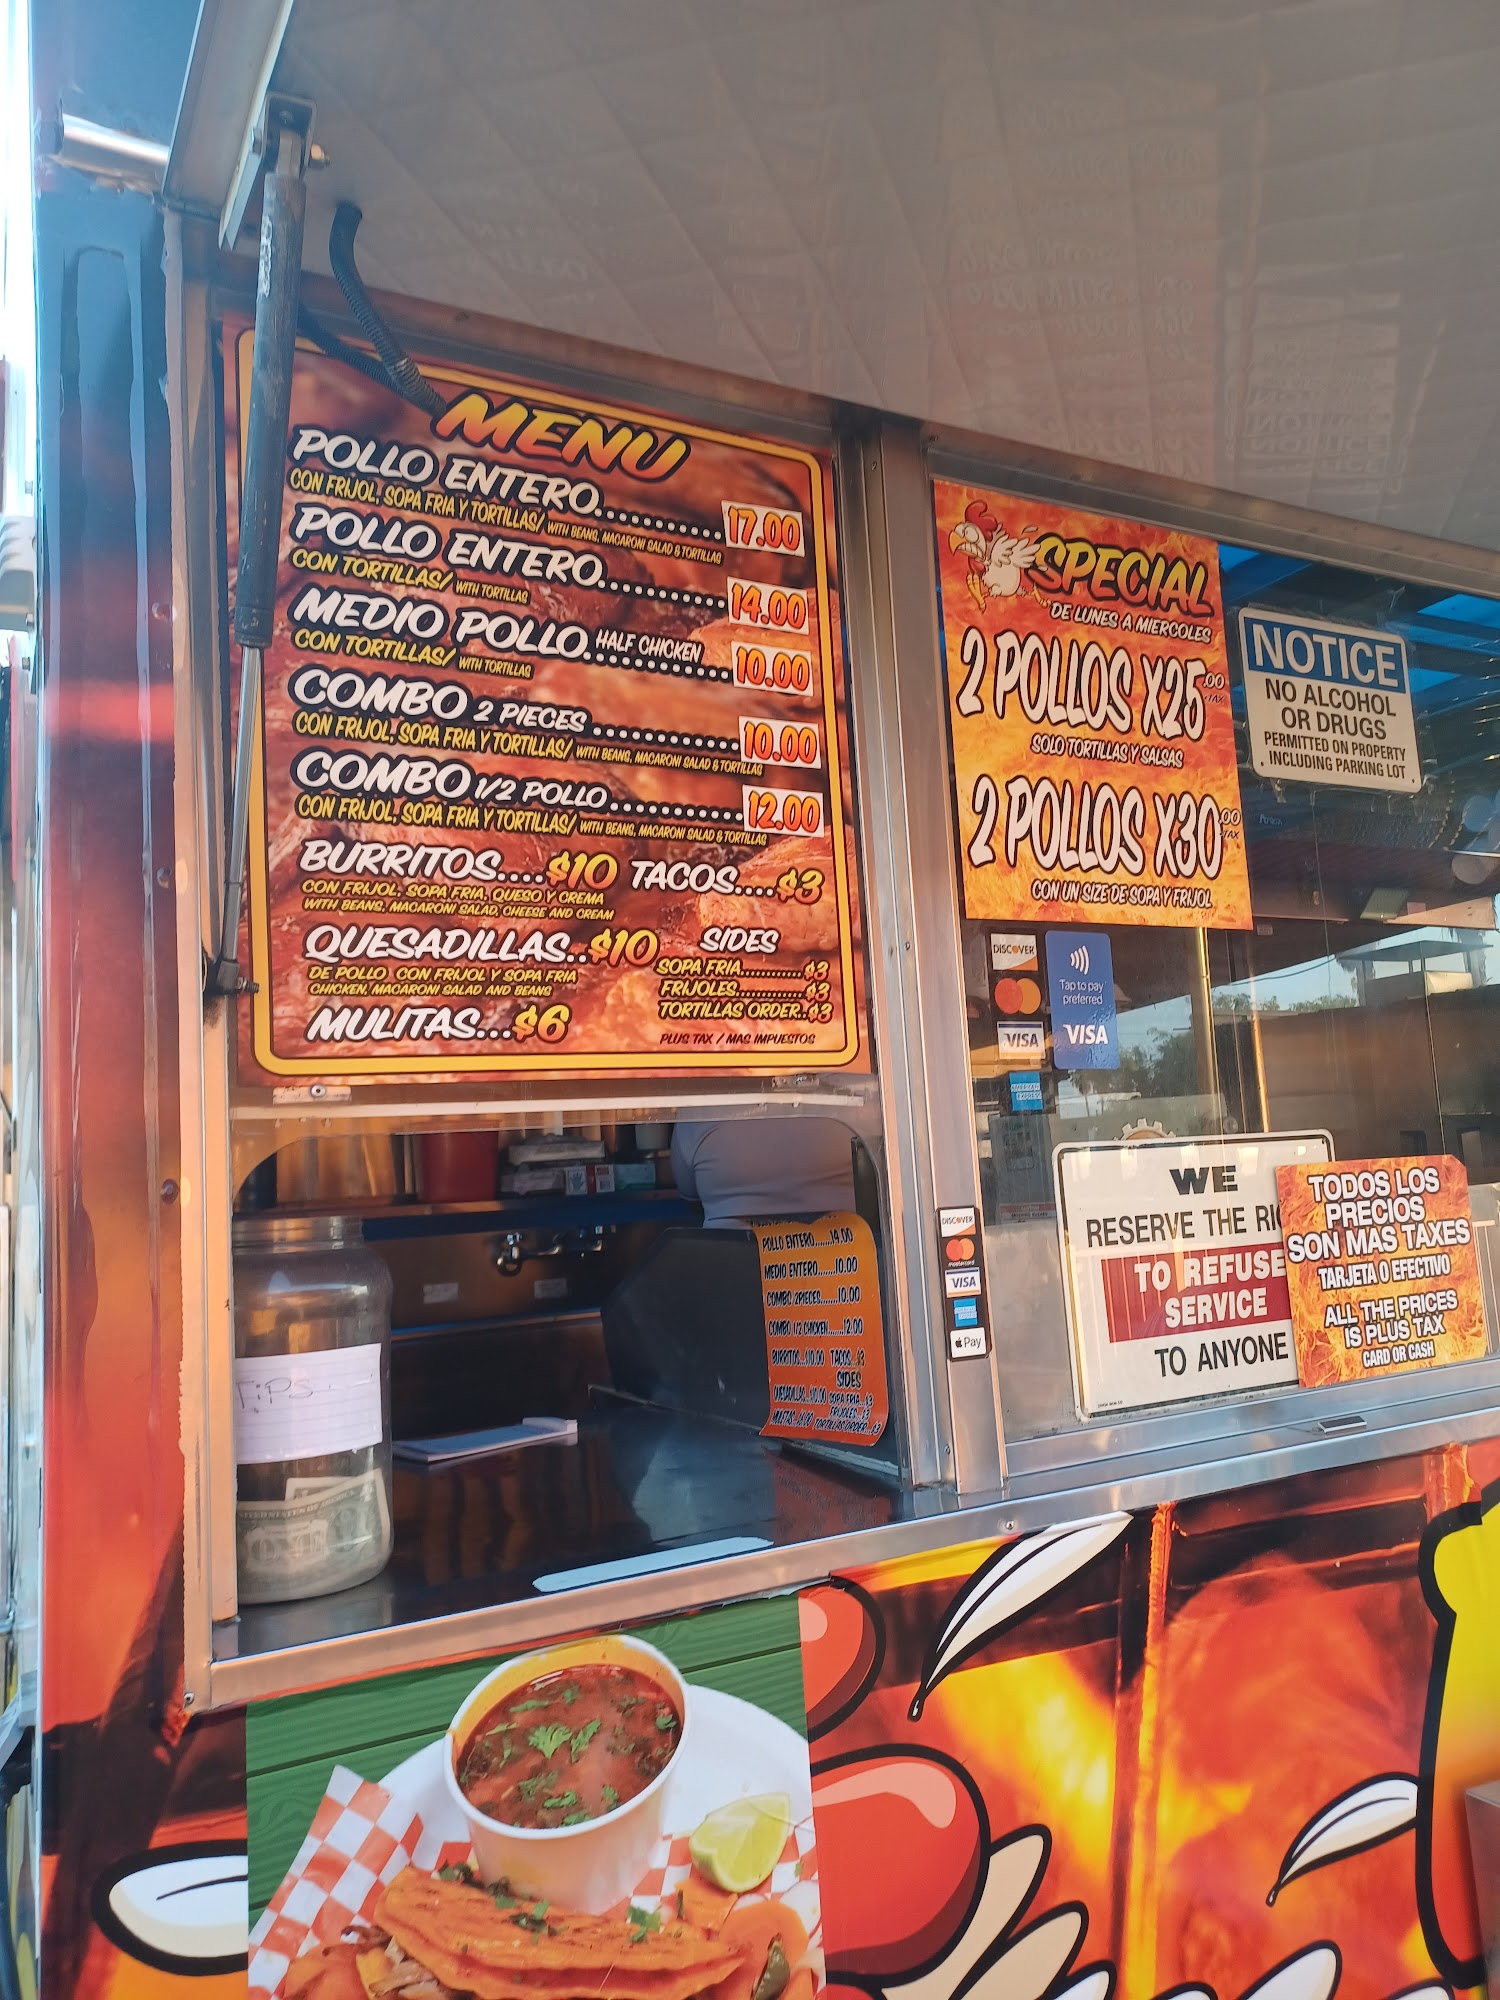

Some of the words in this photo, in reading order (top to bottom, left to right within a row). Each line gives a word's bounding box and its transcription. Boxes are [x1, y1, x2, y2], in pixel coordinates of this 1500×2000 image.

[434, 392, 688, 481] MENU
[290, 468, 325, 490] CON
[383, 485, 422, 511] SOPA
[424, 493, 455, 517] FRIA
[293, 429, 434, 483] POLLO
[728, 505, 800, 550] 17.00
[292, 549, 338, 573] CON
[456, 580, 479, 595] WITH
[481, 584, 528, 604] TORTILLAS
[295, 506, 436, 558] POLLO
[732, 582, 806, 629] 14.00
[1028, 535, 1214, 617] SPECIAL
[293, 587, 444, 638] MEDIO
[596, 629, 637, 652] HALF
[638, 635, 702, 663] CHICKEN
[736, 647, 809, 691] 10.00
[1051, 603, 1071, 618] DE
[1074, 607, 1118, 627] LUNES
[1122, 614, 1132, 630] A
[1135, 615, 1212, 643] MIERCOLES
[294, 628, 339, 652] CON
[459, 656, 482, 671] WITH
[484, 659, 531, 678] TORTILLAS
[1252, 623, 1398, 688] NOTICE
[958, 627, 986, 716] 2
[995, 631, 1132, 732] POLLOS
[1265, 678, 1297, 703] NO
[1304, 684, 1396, 716] ALCOHOL
[294, 669, 468, 720] COMBO
[473, 700, 494, 722] 2
[744, 721, 817, 764] 10.00
[1281, 706, 1311, 731] OR
[1316, 711, 1387, 740] DRUGS
[1032, 734, 1064, 755] SOLO
[1067, 738, 1128, 762] TORTILLAS
[1141, 746, 1184, 768] SALSAS
[1264, 731, 1329, 753] PERMITTED
[1332, 740, 1349, 755] ON
[1352, 742, 1406, 762] PROPERTY
[1269, 751, 1333, 771] INCLUDING
[1336, 757, 1384, 777] PARKING
[1386, 763, 1406, 779] LOT
[296, 751, 471, 799] COMBO
[475, 777, 516, 801] 1/2
[749, 791, 819, 832] 12.00
[298, 794, 335, 817] CON
[338, 798, 396, 823] FRIJOL,
[401, 802, 443, 825] SOPA
[446, 806, 479, 828] FRIA
[580, 820, 603, 833] WITH
[605, 823, 636, 837] BEANS,
[638, 825, 686, 840] MACARONI
[687, 828, 714, 842] SALAD
[724, 831, 766, 846] TORTILLAS
[969, 774, 998, 867] 2
[1005, 775, 1145, 875] POLLOS
[302, 880, 339, 895] CON
[342, 882, 401, 897] FRIJOL,
[406, 884, 448, 898] SOPA
[492, 887, 541, 903] QUESO
[558, 891, 604, 905] CREMA
[304, 898, 338, 911] WITH
[389, 901, 456, 914] MACARONI
[502, 905, 547, 918] CHEESE
[549, 907, 573, 919] AND
[576, 907, 614, 920] CREAM
[1032, 880, 1059, 900] CON
[1061, 882, 1080, 900] UN
[1082, 883, 1109, 902] SIZE
[1110, 885, 1128, 904] DE
[1130, 886, 1162, 906] SOPA
[1172, 889, 1212, 908] FRIJOL
[700, 928, 779, 953] SIDES
[993, 943, 1035, 955] DISCOVER
[309, 967, 331, 980] DE
[335, 967, 387, 981] POLLO
[396, 968, 431, 981] CON
[433, 969, 487, 982] FRIJOL
[502, 969, 542, 983] SOPA
[545, 970, 577, 983] FRIA
[656, 958, 702, 975] SOPA
[371, 984, 439, 995] MACARONI
[442, 984, 482, 996] SALAD
[485, 985, 511, 996] AND
[514, 985, 552, 997] BEANS
[1059, 979, 1076, 991] Tap
[1077, 980, 1086, 991] to
[1088, 981, 1104, 993] pay
[1063, 993, 1104, 1005] preferred
[659, 1002, 743, 1019] TORTILLAS
[660, 1034, 690, 1045] PLUS
[693, 1034, 712, 1044] TAX
[726, 1034, 751, 1044] MAS
[754, 1034, 816, 1044] IMPUESTOS
[1003, 1032, 1039, 1048] VISA
[1063, 1024, 1108, 1045] VISA
[1169, 1165, 1239, 1196] WE
[1308, 1170, 1391, 1201] TODOS
[1395, 1166, 1440, 1195] LOS
[942, 1215, 974, 1225] DISCOVER
[1087, 1211, 1195, 1248] RESERVE
[1203, 1207, 1247, 1237] THE
[1325, 1196, 1426, 1229] PRECIOS
[761, 1235, 785, 1253] POLLO
[1288, 1231, 1342, 1263] SON
[1347, 1226, 1398, 1256] MAS
[1402, 1218, 1471, 1250] TAXES
[764, 1263, 787, 1280] MEDIO
[950, 1276, 977, 1289] VISA
[1134, 1260, 1171, 1293] TO
[1184, 1249, 1287, 1288] REFUSE
[1318, 1261, 1378, 1290] TARJETA
[1379, 1260, 1390, 1283] O
[1391, 1254, 1451, 1282] EFECTIVO
[767, 1290, 792, 1307] COMBO
[1165, 1287, 1268, 1329] SERVICE
[1324, 1304, 1358, 1327] ALL
[1360, 1298, 1395, 1320] THE
[1398, 1290, 1458, 1317] PRICES
[964, 1336, 982, 1349] Pay
[1344, 1326, 1362, 1348] IS
[1366, 1319, 1410, 1345] PLUS
[1412, 1315, 1446, 1338] TAX
[1155, 1346, 1187, 1377] TO
[1198, 1332, 1289, 1372] ANYONE
[1363, 1348, 1390, 1368] CARD
[1392, 1347, 1407, 1362] OR
[1408, 1341, 1435, 1360] CASH
[836, 1370, 862, 1389] SIDES
